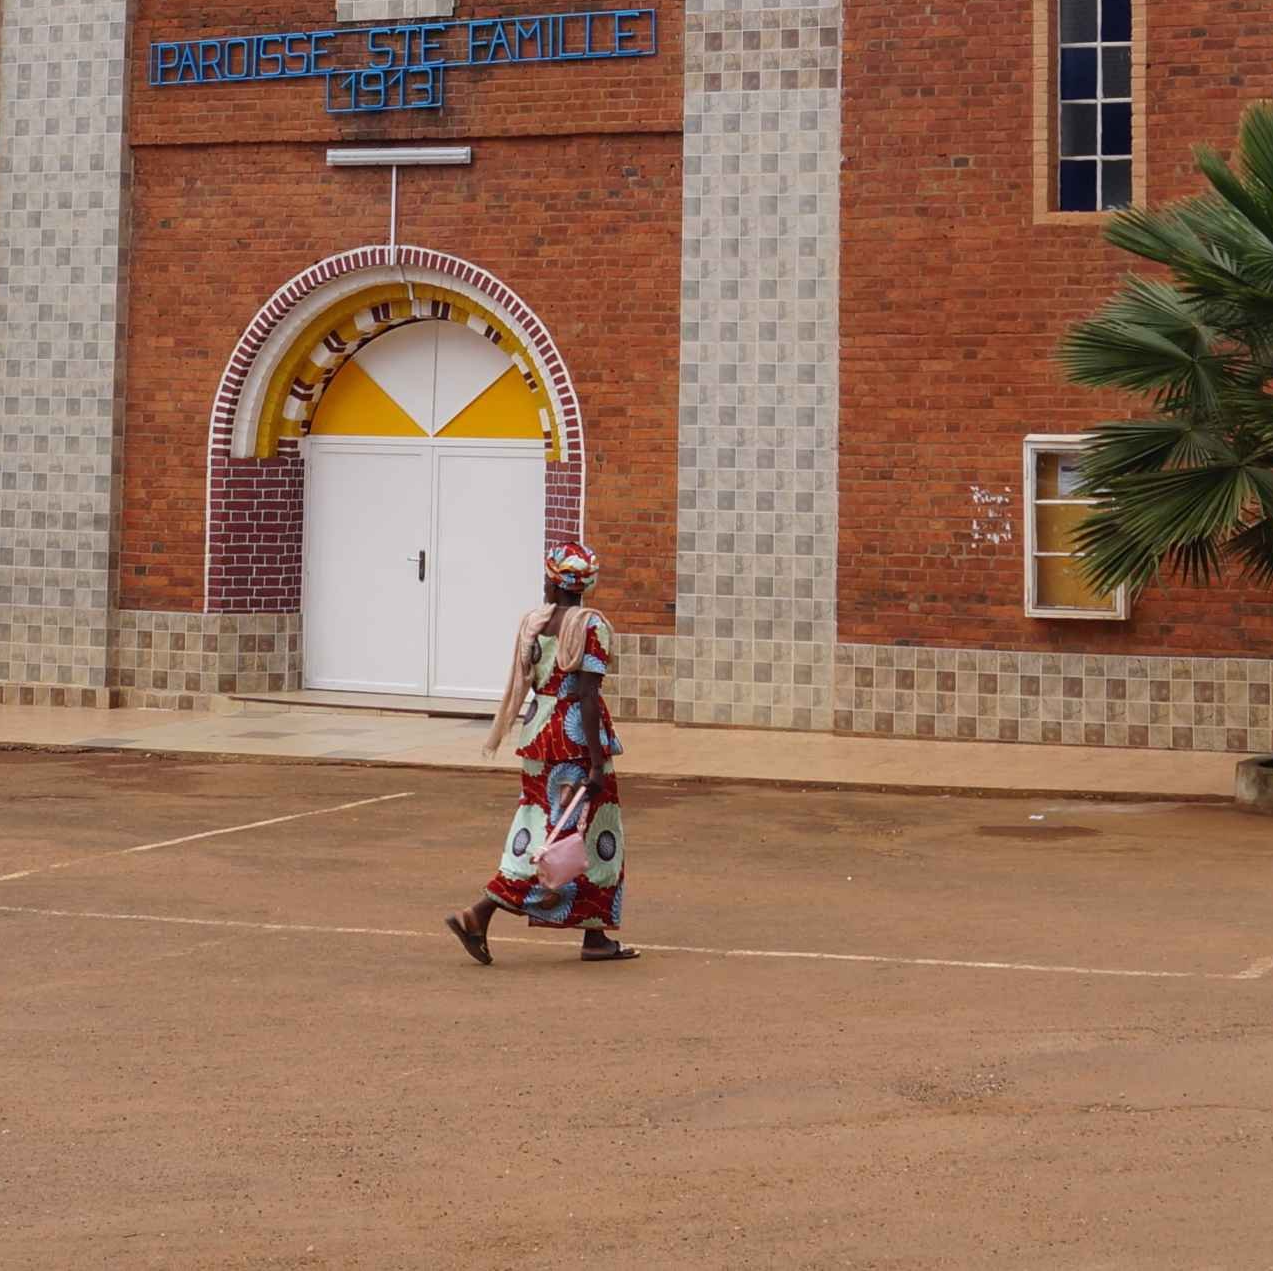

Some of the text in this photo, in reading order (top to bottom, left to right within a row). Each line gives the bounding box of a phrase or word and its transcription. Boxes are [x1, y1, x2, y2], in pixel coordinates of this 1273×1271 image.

[158, 10, 640, 85] PAROISSE STE FAMILLE
[340, 68, 433, 109] 1913
